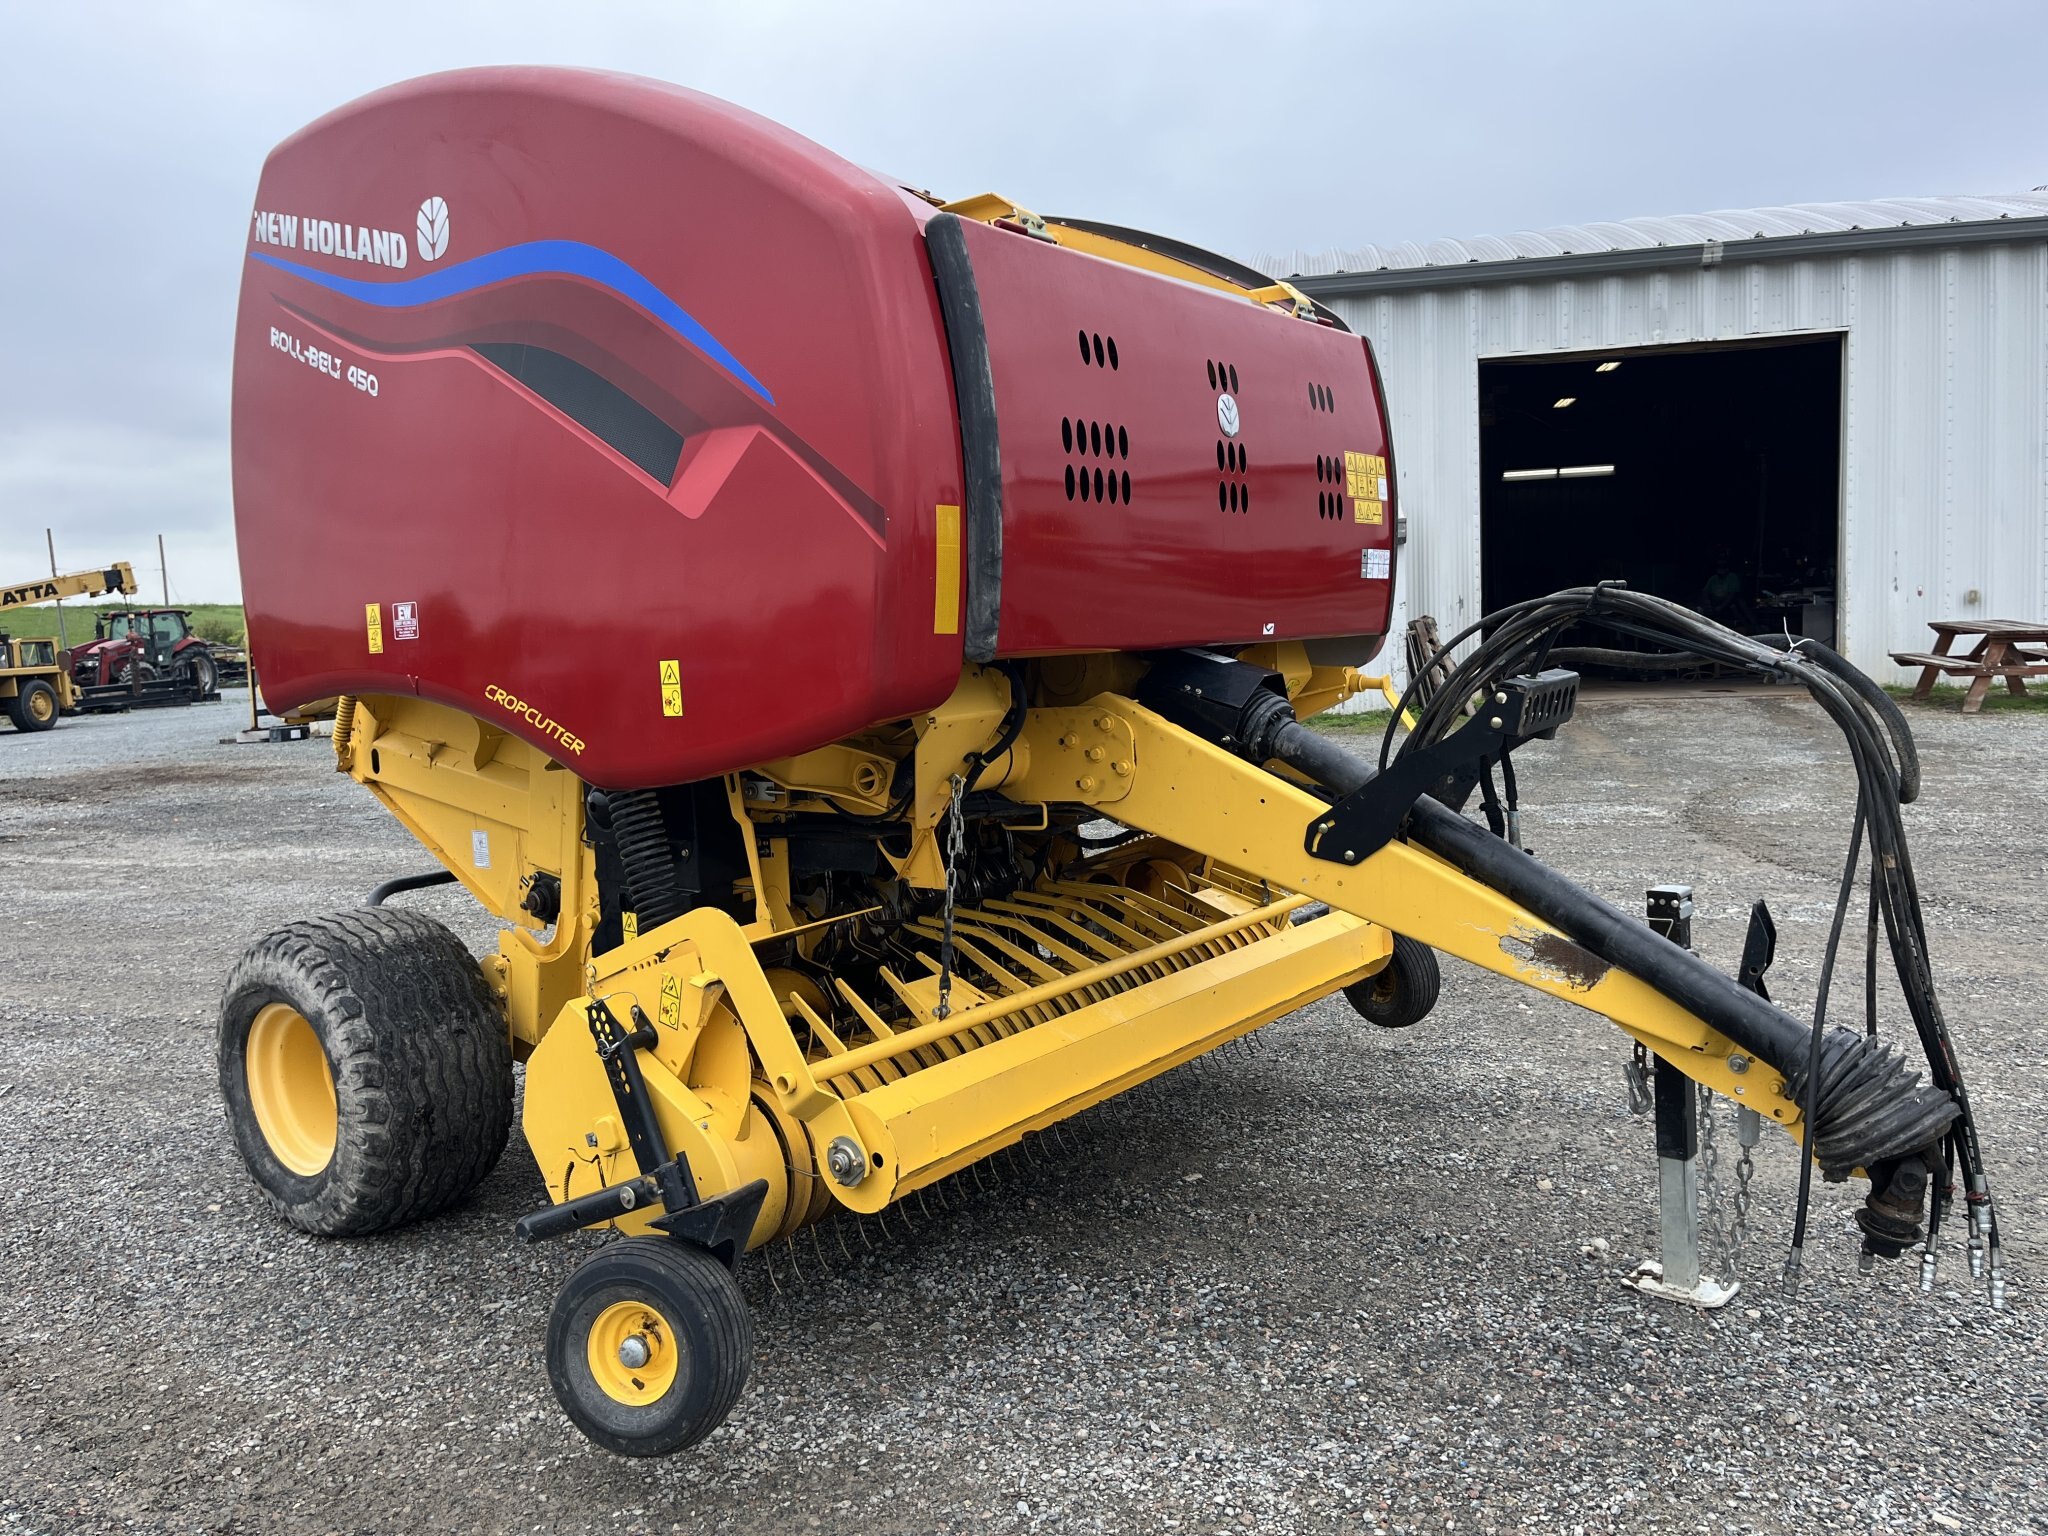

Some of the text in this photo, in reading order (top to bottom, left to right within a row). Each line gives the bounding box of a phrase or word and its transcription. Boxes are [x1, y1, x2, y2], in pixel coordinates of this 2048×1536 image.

[254, 210, 408, 269] NEW HOLLAND
[270, 326, 379, 397] ROLL-BELT 450
[0, 583, 58, 606] ATTA
[484, 684, 586, 756] CROPCUTTER
